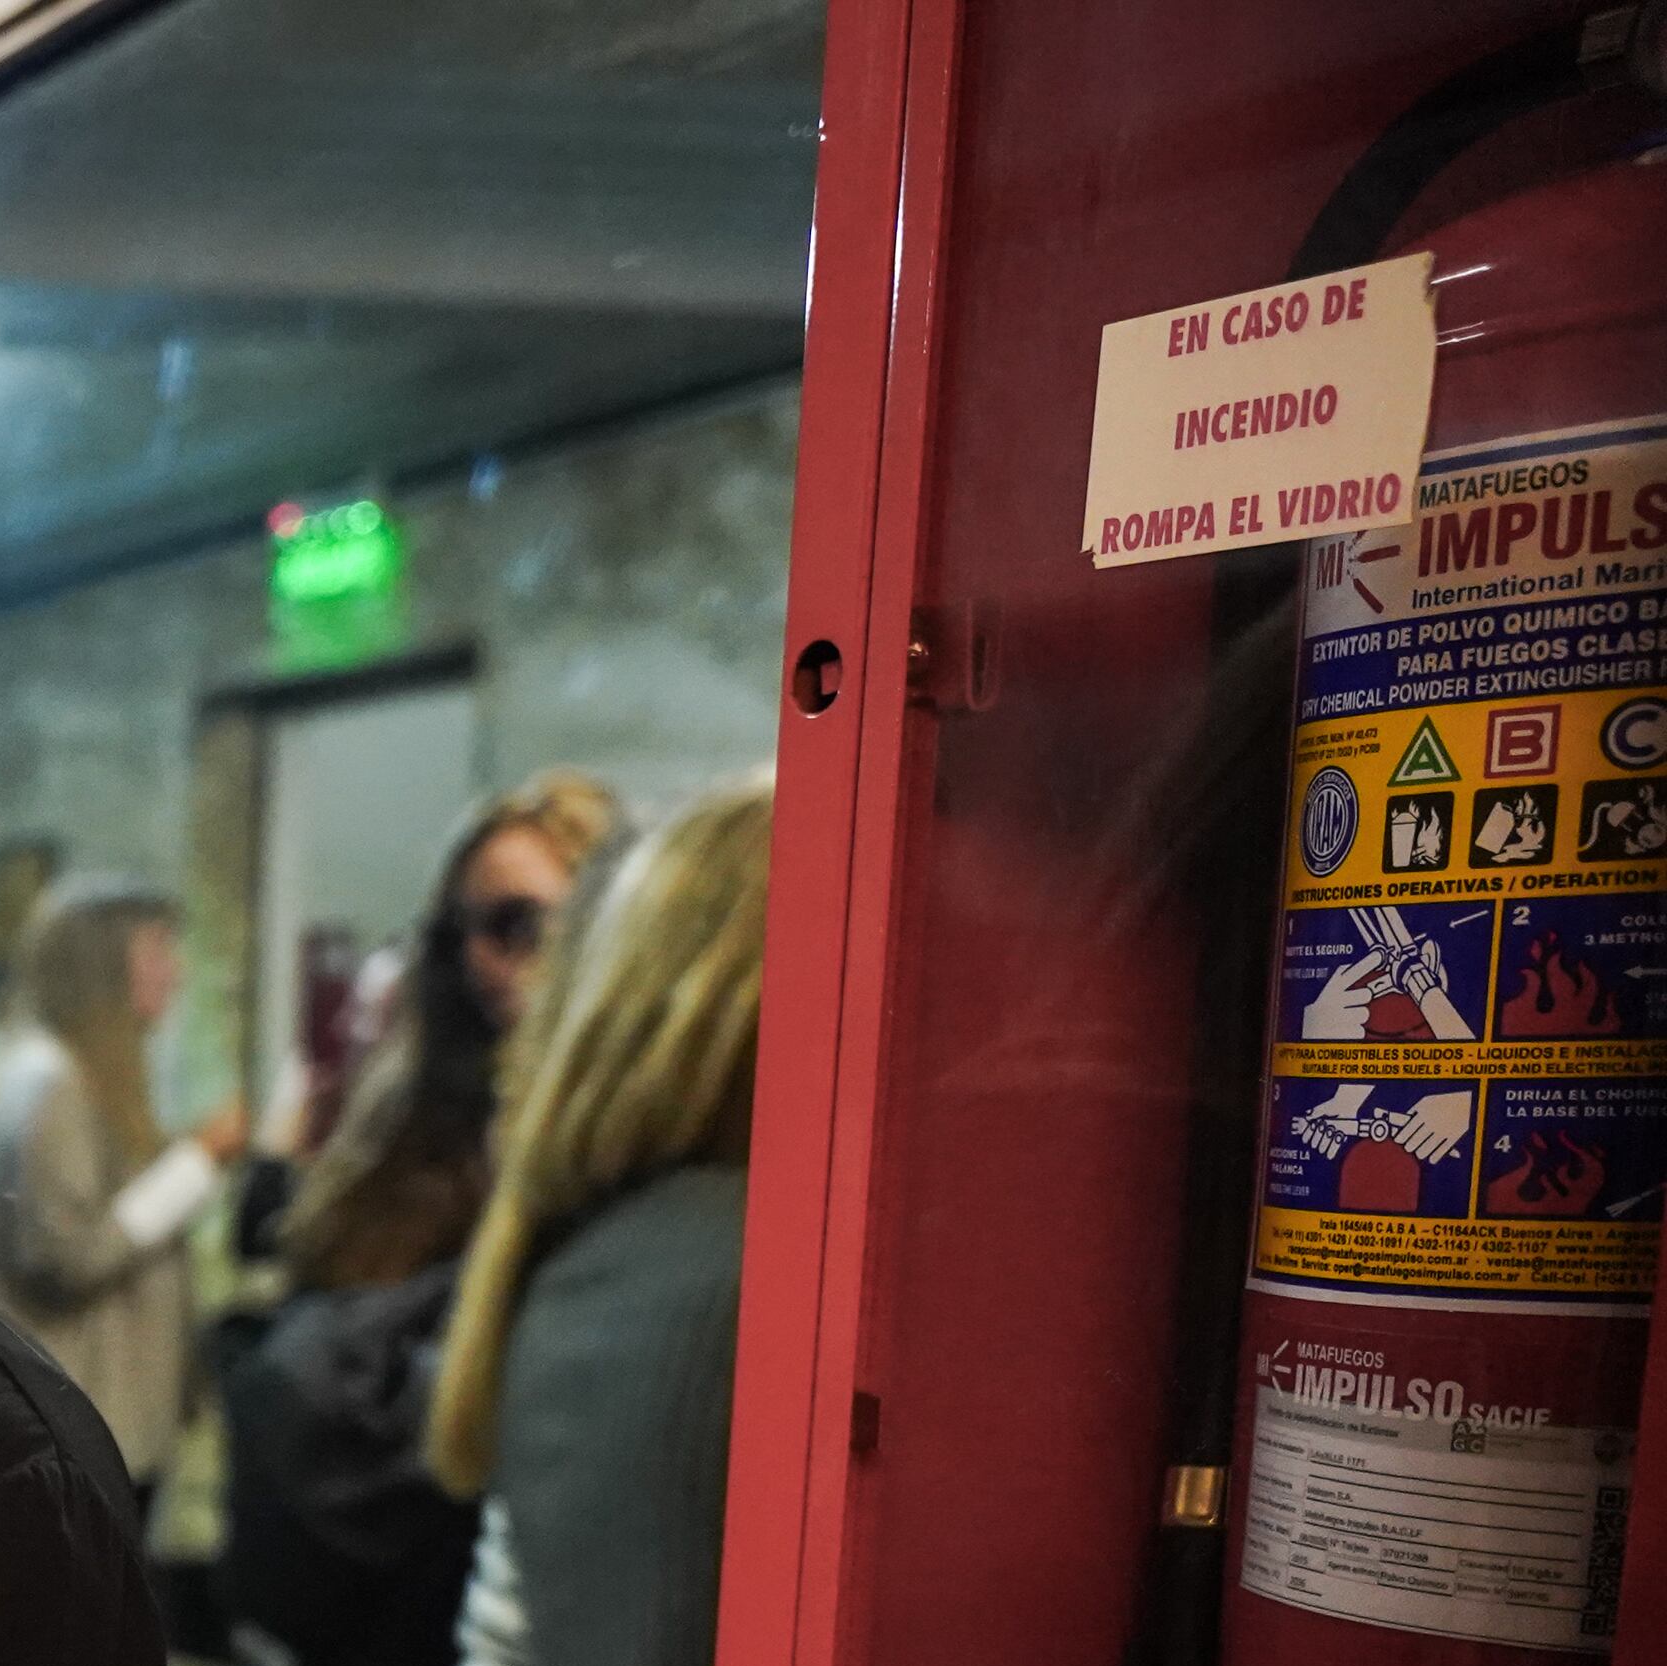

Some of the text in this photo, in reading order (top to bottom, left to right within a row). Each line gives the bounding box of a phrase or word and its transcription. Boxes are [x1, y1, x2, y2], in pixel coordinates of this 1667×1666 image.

[1167, 278, 1366, 357] EN CASO DE
[1174, 384, 1338, 449] INCENDIO
[1419, 459, 1588, 509] MATAFUEGOS
[1100, 472, 1401, 554] ROMPA EL VIDRIO
[1412, 567, 1583, 609] International
[1312, 632, 1382, 664] EXTINTOR
[1386, 627, 1412, 650] DE
[1418, 616, 1495, 645] POLVO
[1503, 601, 1629, 635] QUIMICO
[1397, 651, 1453, 677] PARA
[1461, 637, 1569, 669] FUEGOS
[1302, 659, 1651, 719] DRY CHEMICAL POWDER EXTINGUISHER
[1498, 719, 1545, 766] B
[1615, 710, 1661, 757] C
[1387, 876, 1503, 899] OPERATIVAS
[1522, 869, 1658, 891] OPERATION
[1512, 905, 1531, 926] 2
[1316, 944, 1353, 956] SEGURO
[1318, 1048, 1399, 1060] COMBUSTIBLES
[1402, 1048, 1463, 1060] SOLIDOS
[1477, 1047, 1553, 1060] LIQUIDOS
[1361, 1063, 1399, 1075] SOLIDS
[1452, 1063, 1506, 1075] LIQUIDS
[1510, 1063, 1541, 1075] AND
[1505, 1089, 1564, 1101] DIRIJA
[1568, 1088, 1592, 1101] EL
[1506, 1106, 1525, 1118] LA
[1532, 1106, 1579, 1118] BASE
[1584, 1105, 1617, 1117] DEL
[1493, 1134, 1512, 1153] 4
[1297, 1341, 1385, 1369] MATAFUEGOS
[1293, 1363, 1464, 1426] IMPULSO
